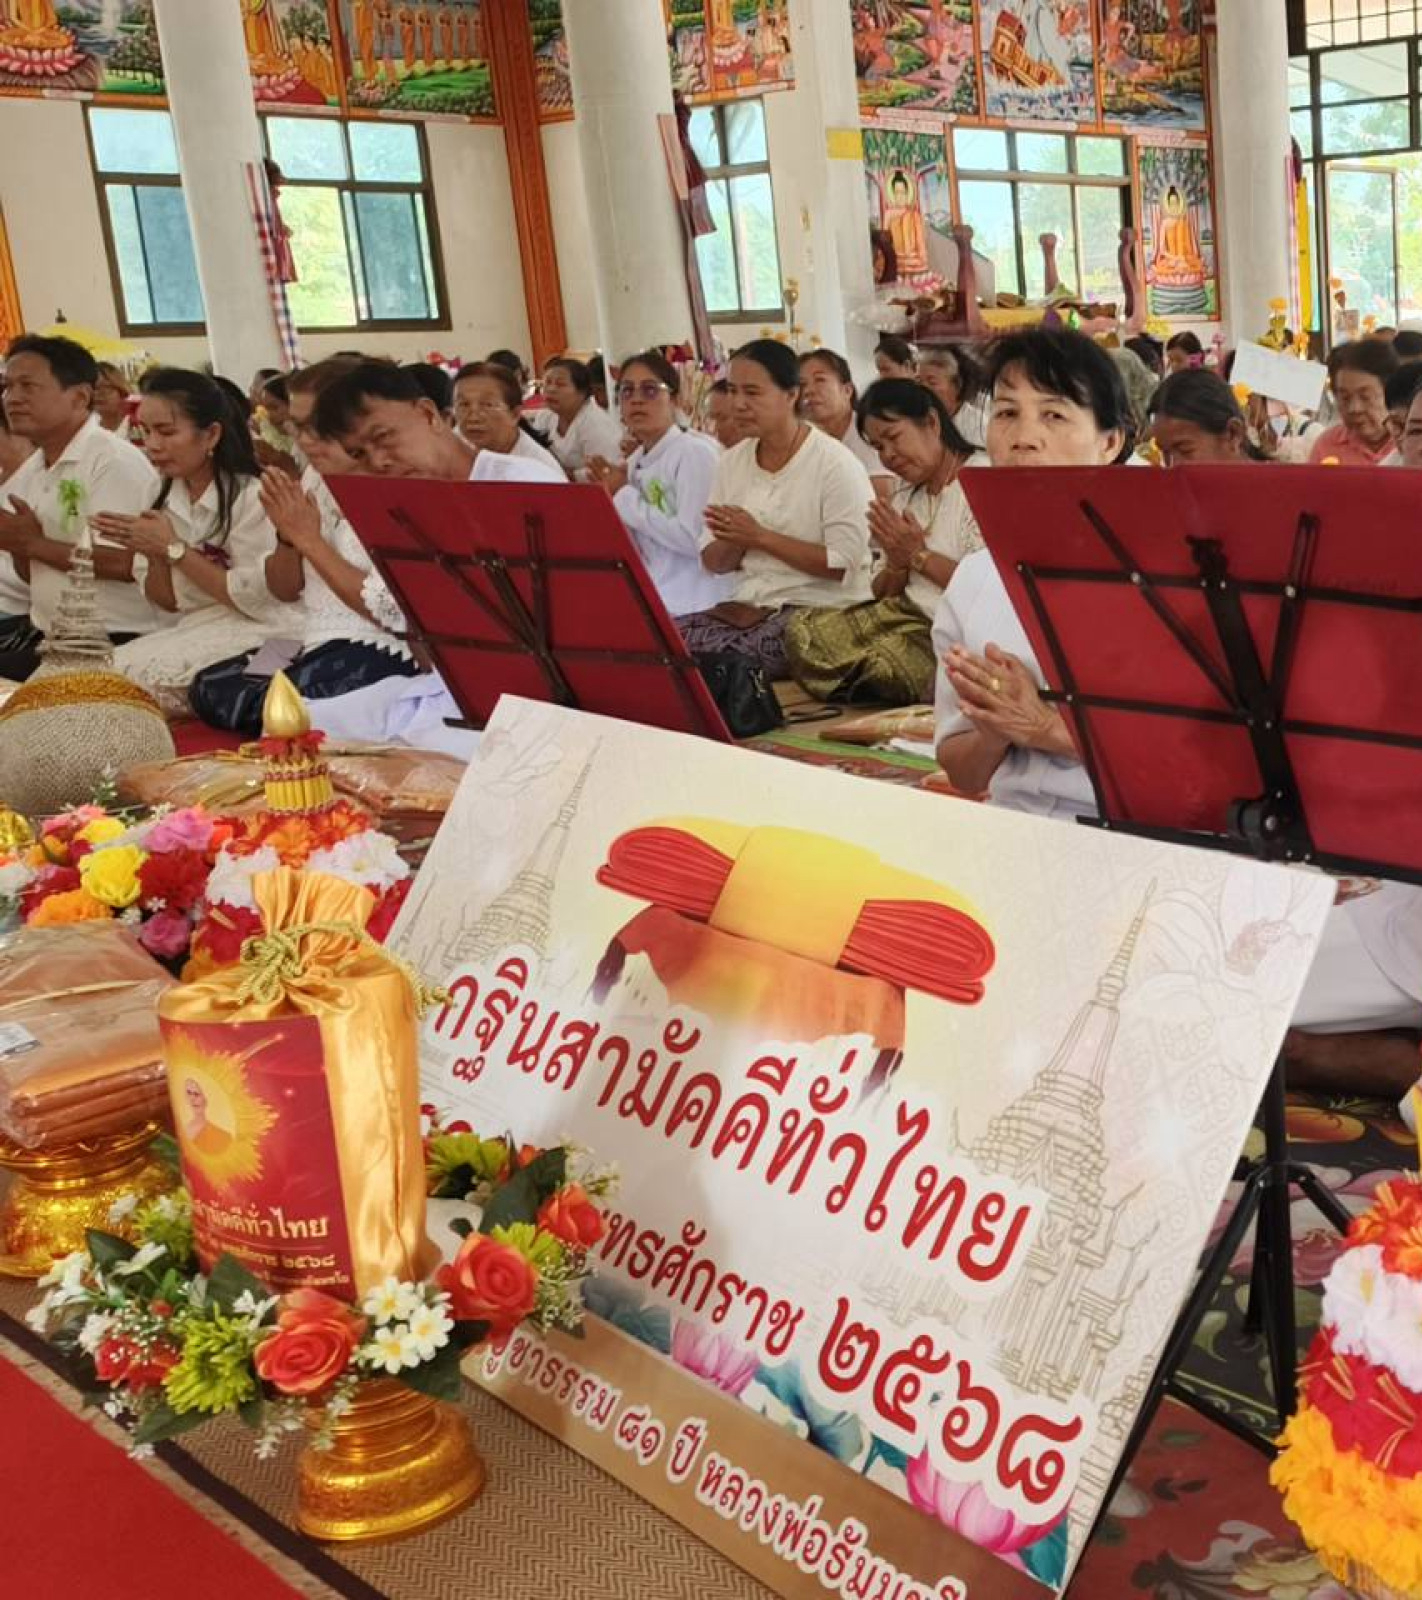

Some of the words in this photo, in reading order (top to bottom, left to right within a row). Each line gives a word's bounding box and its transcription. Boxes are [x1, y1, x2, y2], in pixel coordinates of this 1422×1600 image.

[434, 957, 1031, 1281] กฐินสามัคคีทั่วไทย
[601, 1209, 804, 1357] ทธศักราช
[819, 1296, 1084, 1505] ๒๕๖๘
[619, 1411, 661, 1459] ๘๑
[670, 1424, 701, 1476] ปี
